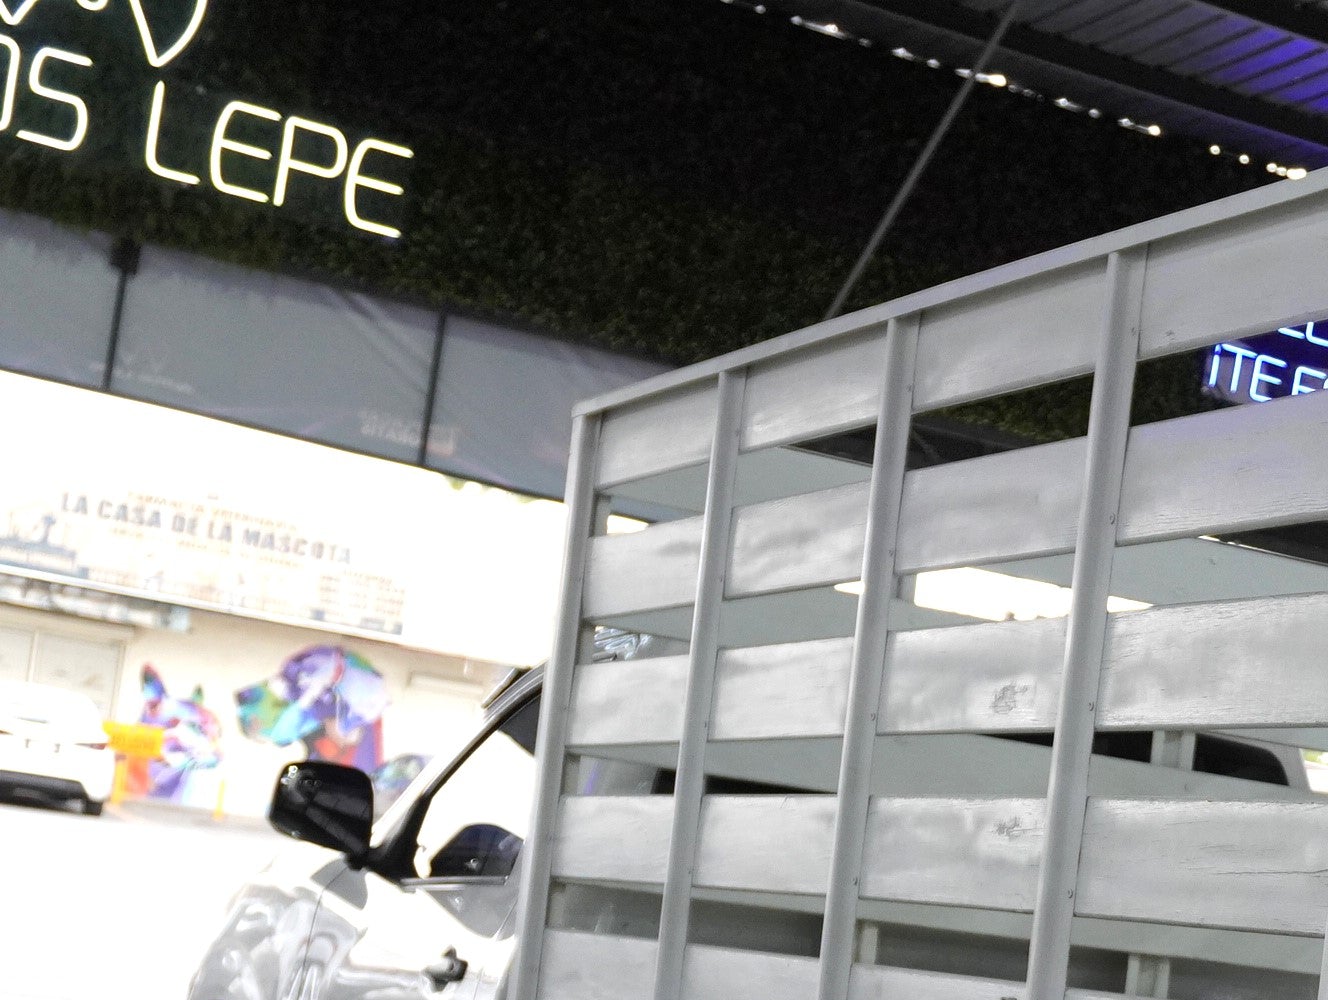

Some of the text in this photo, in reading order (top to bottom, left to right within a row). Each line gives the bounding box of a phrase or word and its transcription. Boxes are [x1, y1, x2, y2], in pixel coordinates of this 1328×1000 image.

[145, 80, 413, 238] LEPE
[61, 492, 88, 515] LA
[98, 499, 161, 528] CASA
[171, 514, 199, 536] DE
[208, 519, 232, 543] LA
[243, 527, 351, 565] MASCOTA
